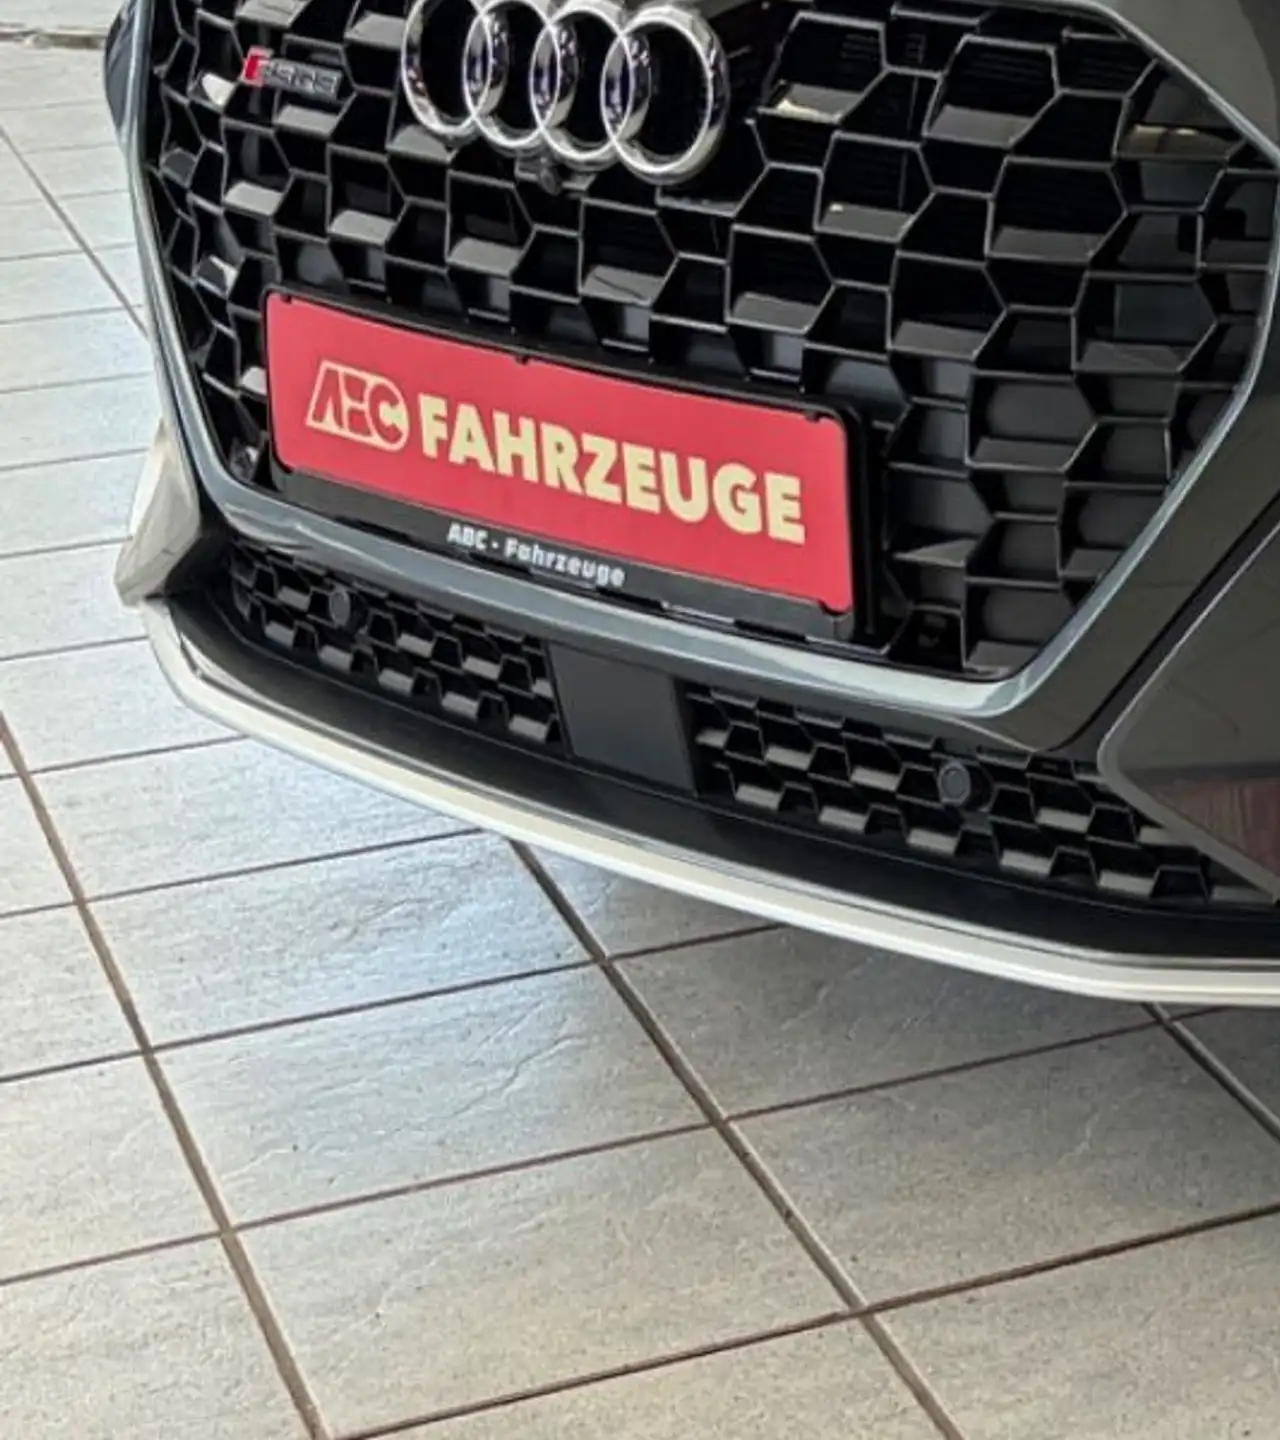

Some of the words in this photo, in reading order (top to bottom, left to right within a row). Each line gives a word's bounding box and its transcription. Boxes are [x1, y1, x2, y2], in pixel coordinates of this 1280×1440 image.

[418, 393, 805, 545] FAHRZEUGE
[447, 522, 488, 551] ABC
[504, 538, 627, 588] Fahrzeuge
